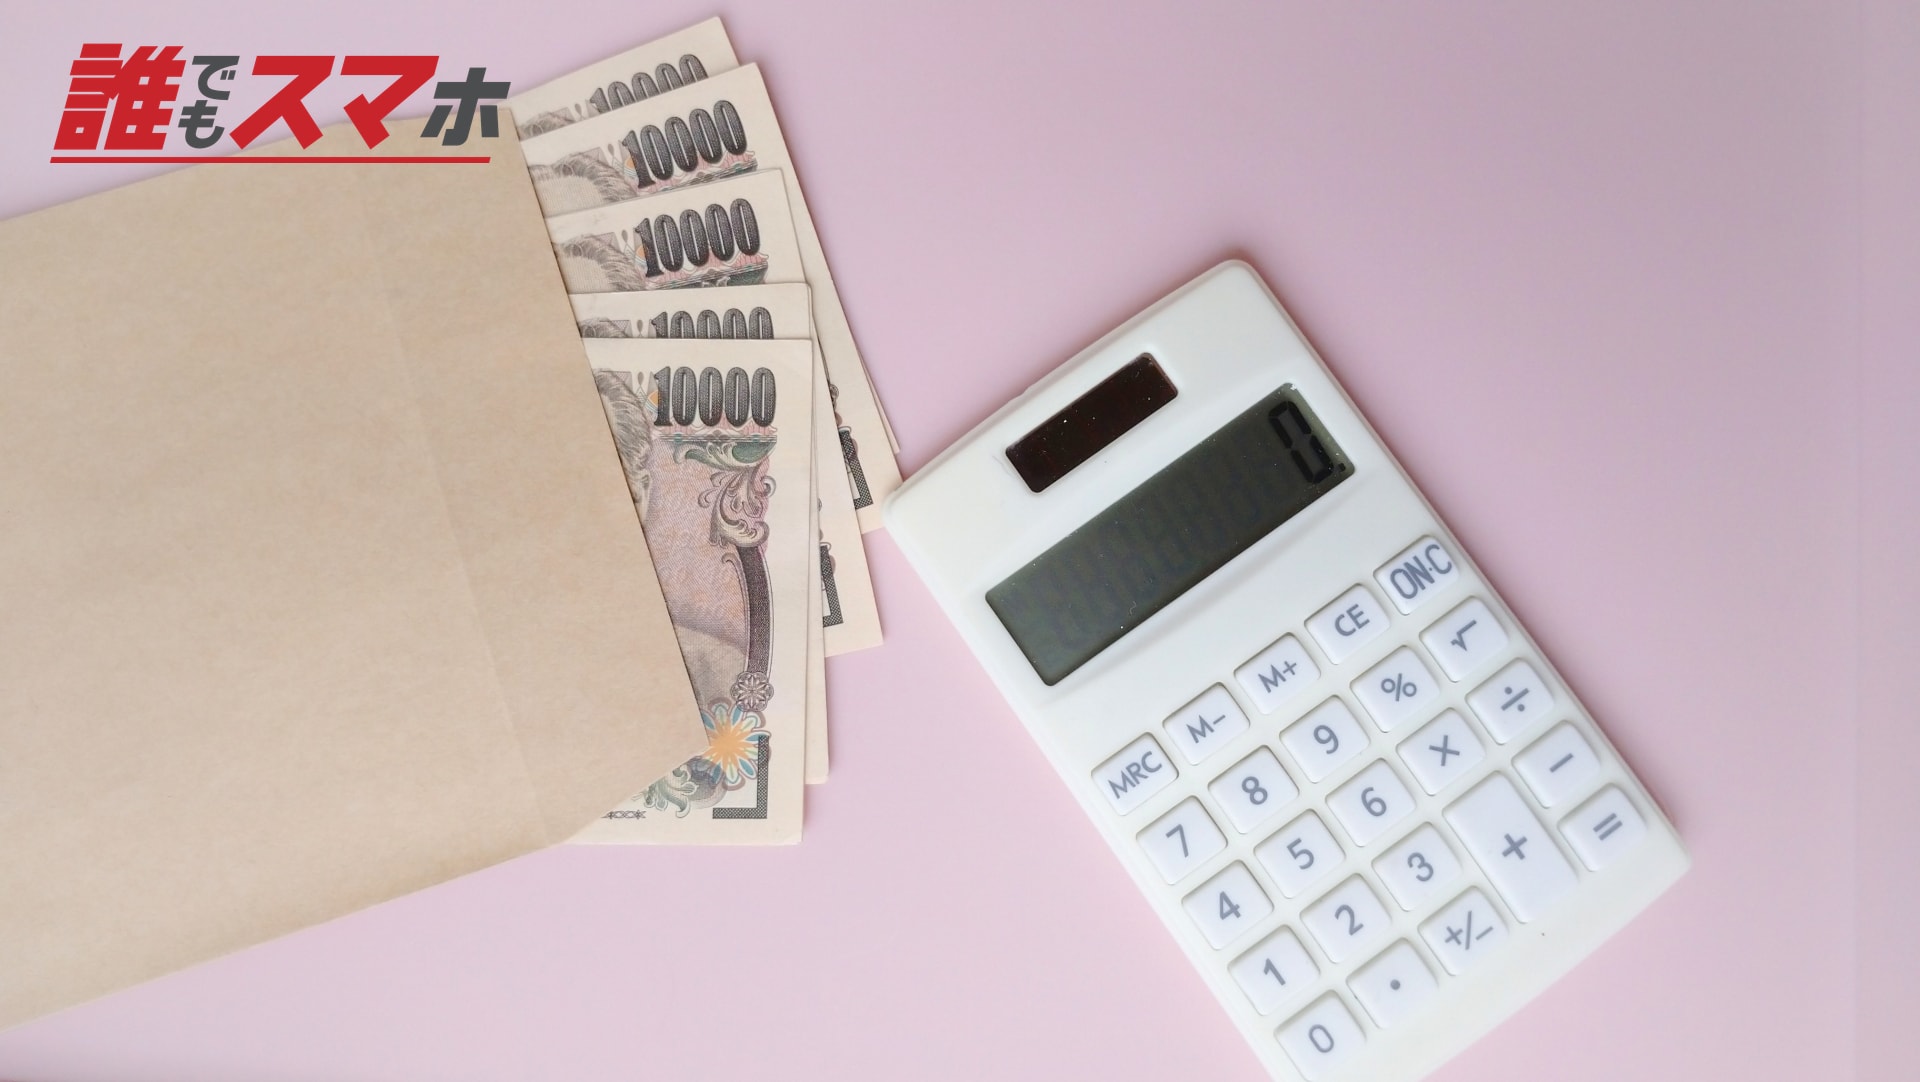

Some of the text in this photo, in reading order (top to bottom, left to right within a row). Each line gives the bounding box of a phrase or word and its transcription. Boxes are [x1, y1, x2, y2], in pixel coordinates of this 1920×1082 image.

[622, 100, 747, 188] 10000
[635, 198, 760, 277] 10000
[654, 366, 776, 427] 10000
[1334, 603, 1370, 637] CE
[1258, 660, 1297, 693] M+
[1381, 673, 1417, 702] %
[1313, 724, 1340, 754] 9
[1108, 751, 1162, 799] MRC
[1241, 776, 1268, 805] 8
[1361, 786, 1387, 817] 6
[1166, 824, 1189, 858] 7
[1287, 838, 1315, 870] 5
[1407, 852, 1434, 882] 3
[1217, 891, 1241, 921] 4
[1334, 904, 1364, 936] 2
[1263, 958, 1286, 986] 1
[1308, 1024, 1335, 1053] 0
